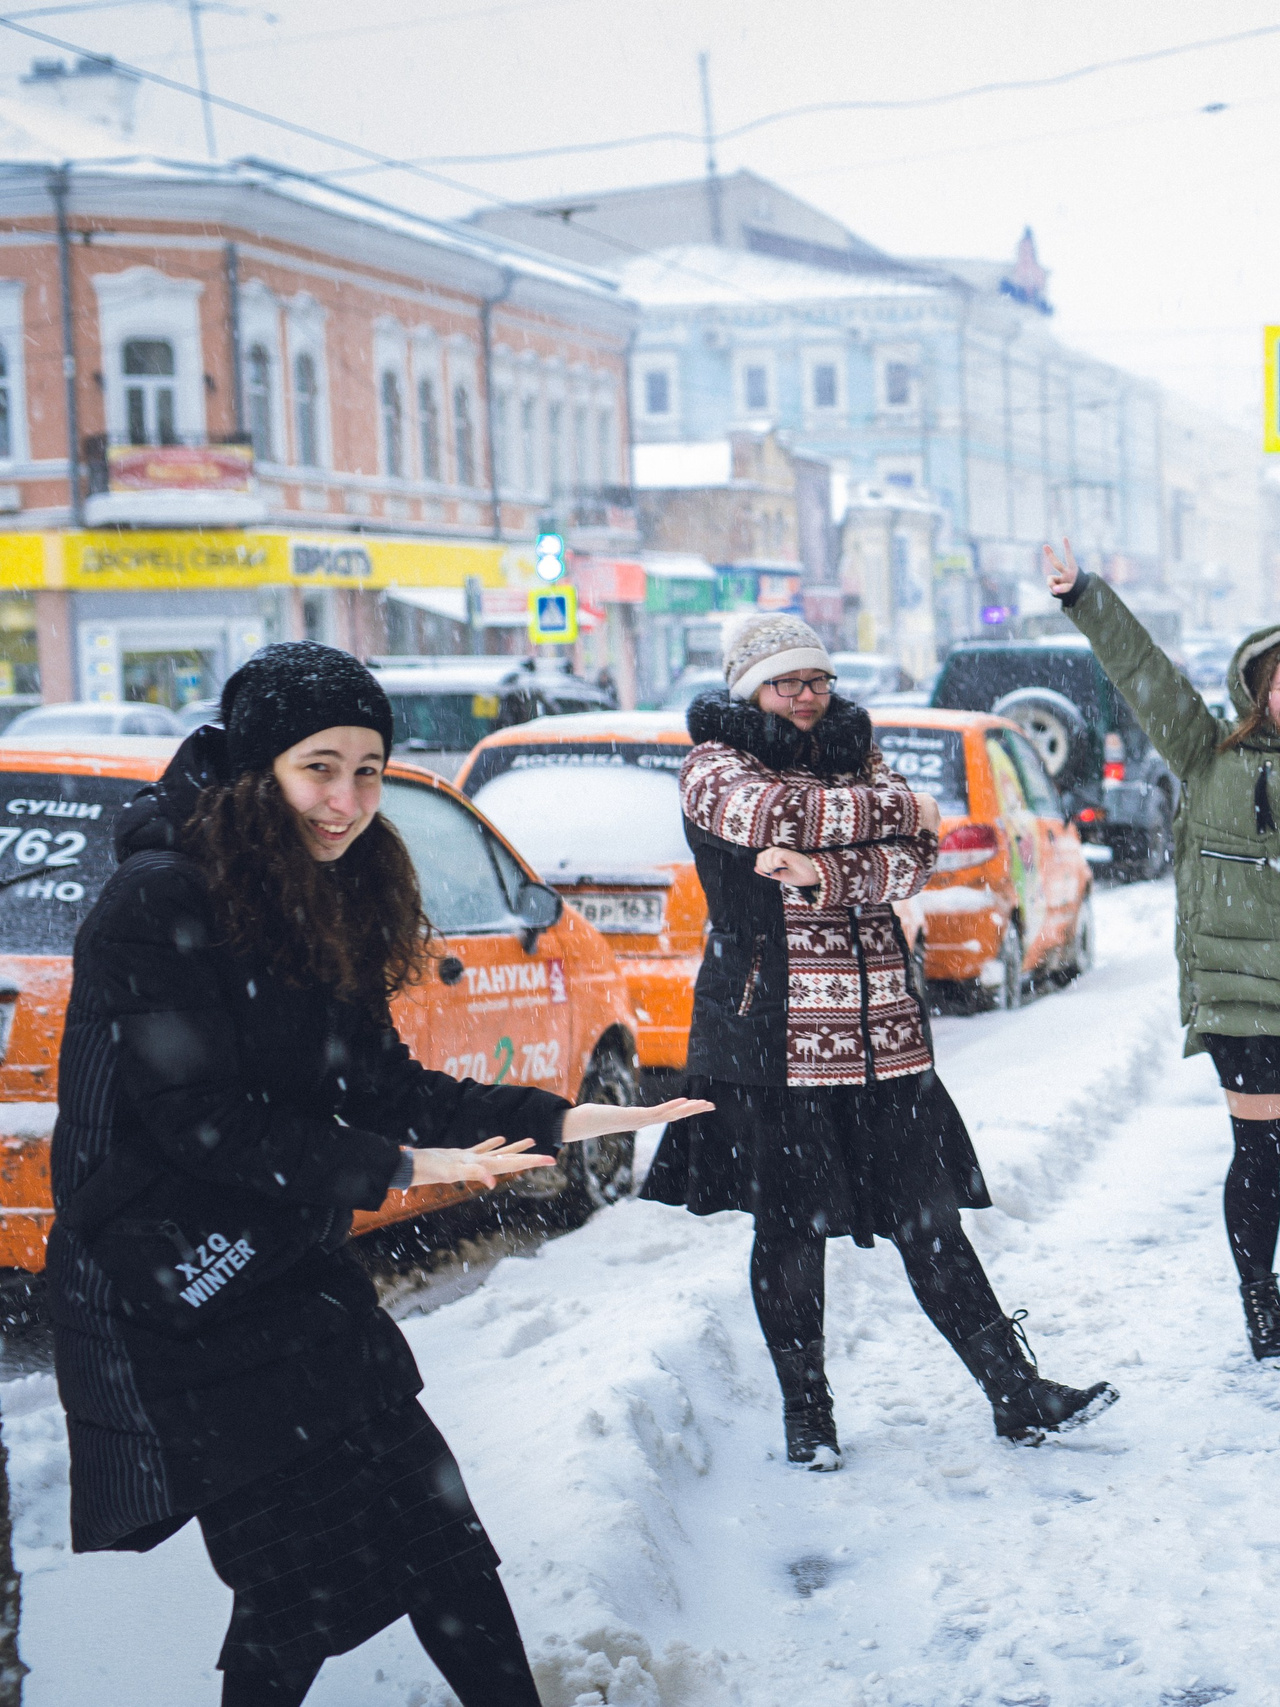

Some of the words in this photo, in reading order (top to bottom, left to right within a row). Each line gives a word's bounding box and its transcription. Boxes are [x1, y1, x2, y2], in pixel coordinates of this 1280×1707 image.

[637, 754, 685, 769] СУШ
[464, 962, 548, 995] ТАНУКИ
[179, 1238, 257, 1308] WINTER
